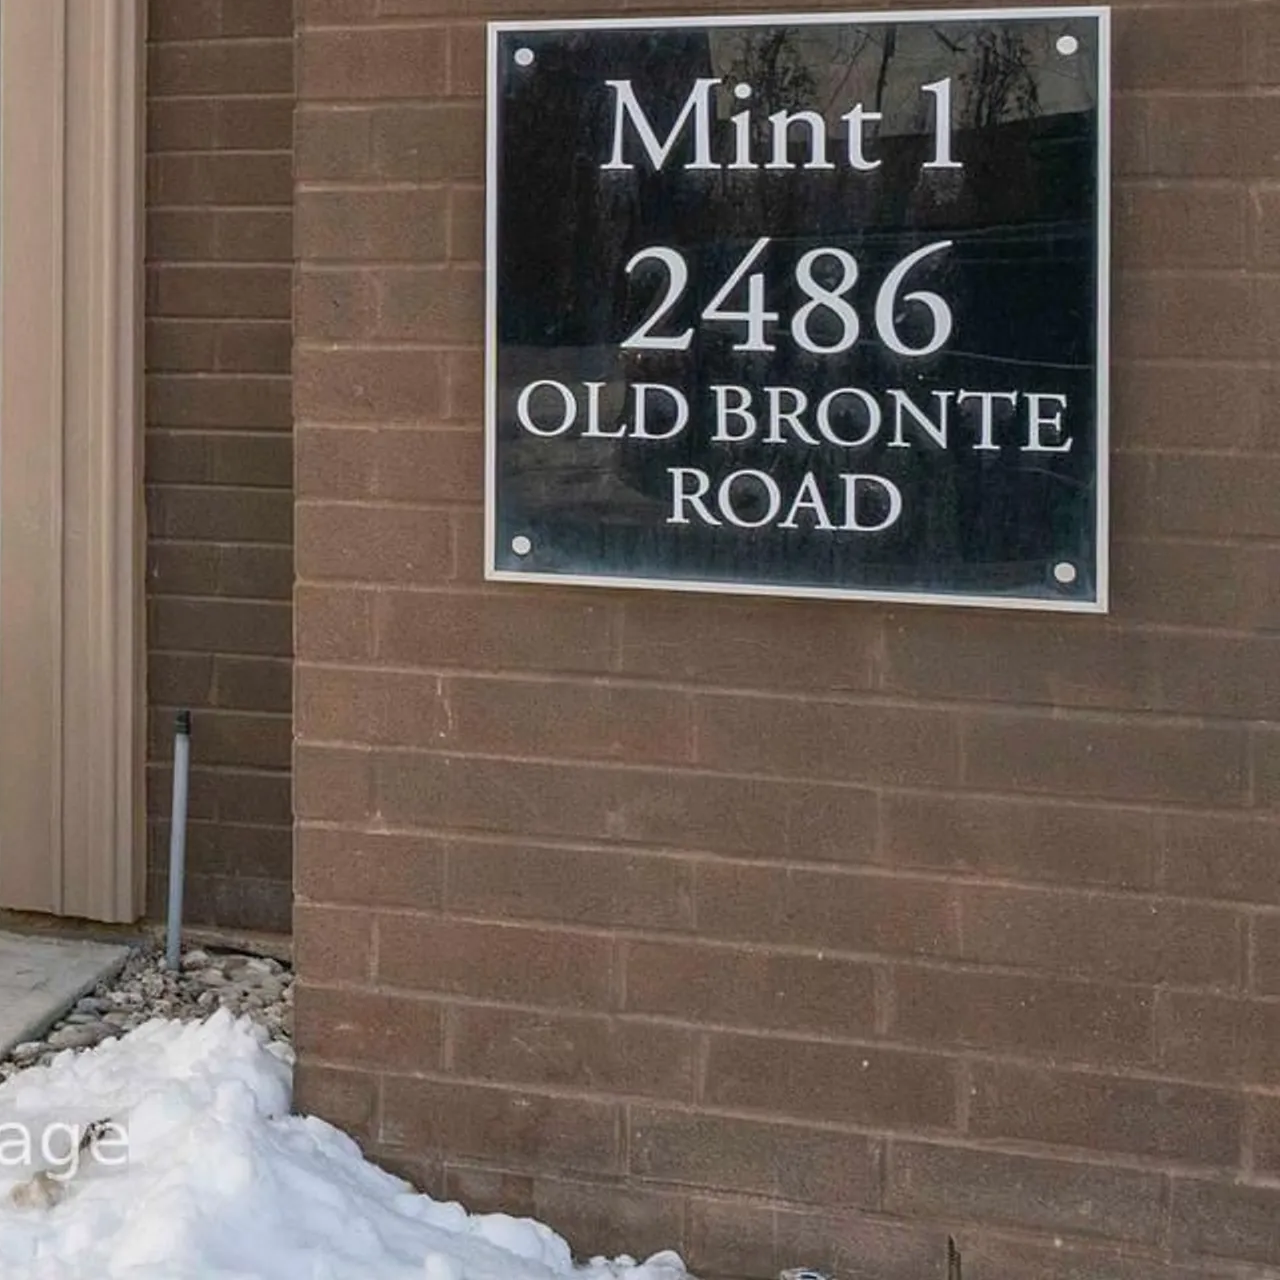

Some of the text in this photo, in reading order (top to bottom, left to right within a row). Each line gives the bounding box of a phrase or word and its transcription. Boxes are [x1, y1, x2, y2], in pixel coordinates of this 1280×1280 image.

[600, 77, 963, 170] Mint 1
[620, 237, 954, 356] 2486
[516, 379, 1073, 452] OLD BRONTE
[666, 467, 902, 532] ROAD
